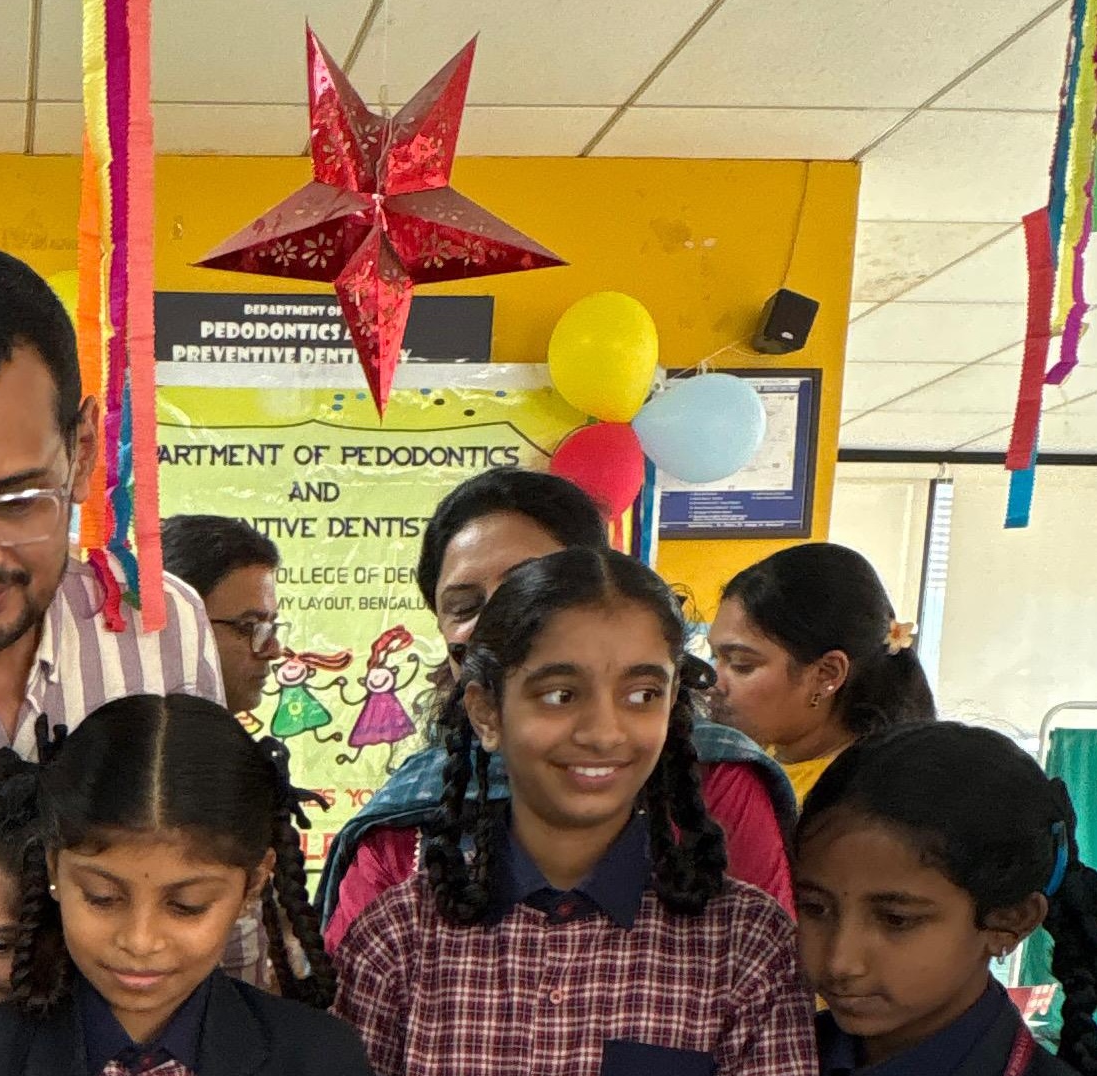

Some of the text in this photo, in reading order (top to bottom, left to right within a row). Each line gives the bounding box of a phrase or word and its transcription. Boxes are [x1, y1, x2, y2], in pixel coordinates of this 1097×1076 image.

[244, 304, 325, 316] DEPARTMENT
[200, 321, 341, 341] PEDODONTICS
[172, 345, 296, 363] PREVENTIVE
[156, 443, 520, 468] ARTMENT OF PEDODONTICS
[288, 481, 340, 502] AND
[276, 567, 348, 584] OLLEGE
[354, 566, 379, 584] OF
[359, 596, 429, 611] BENGALU
